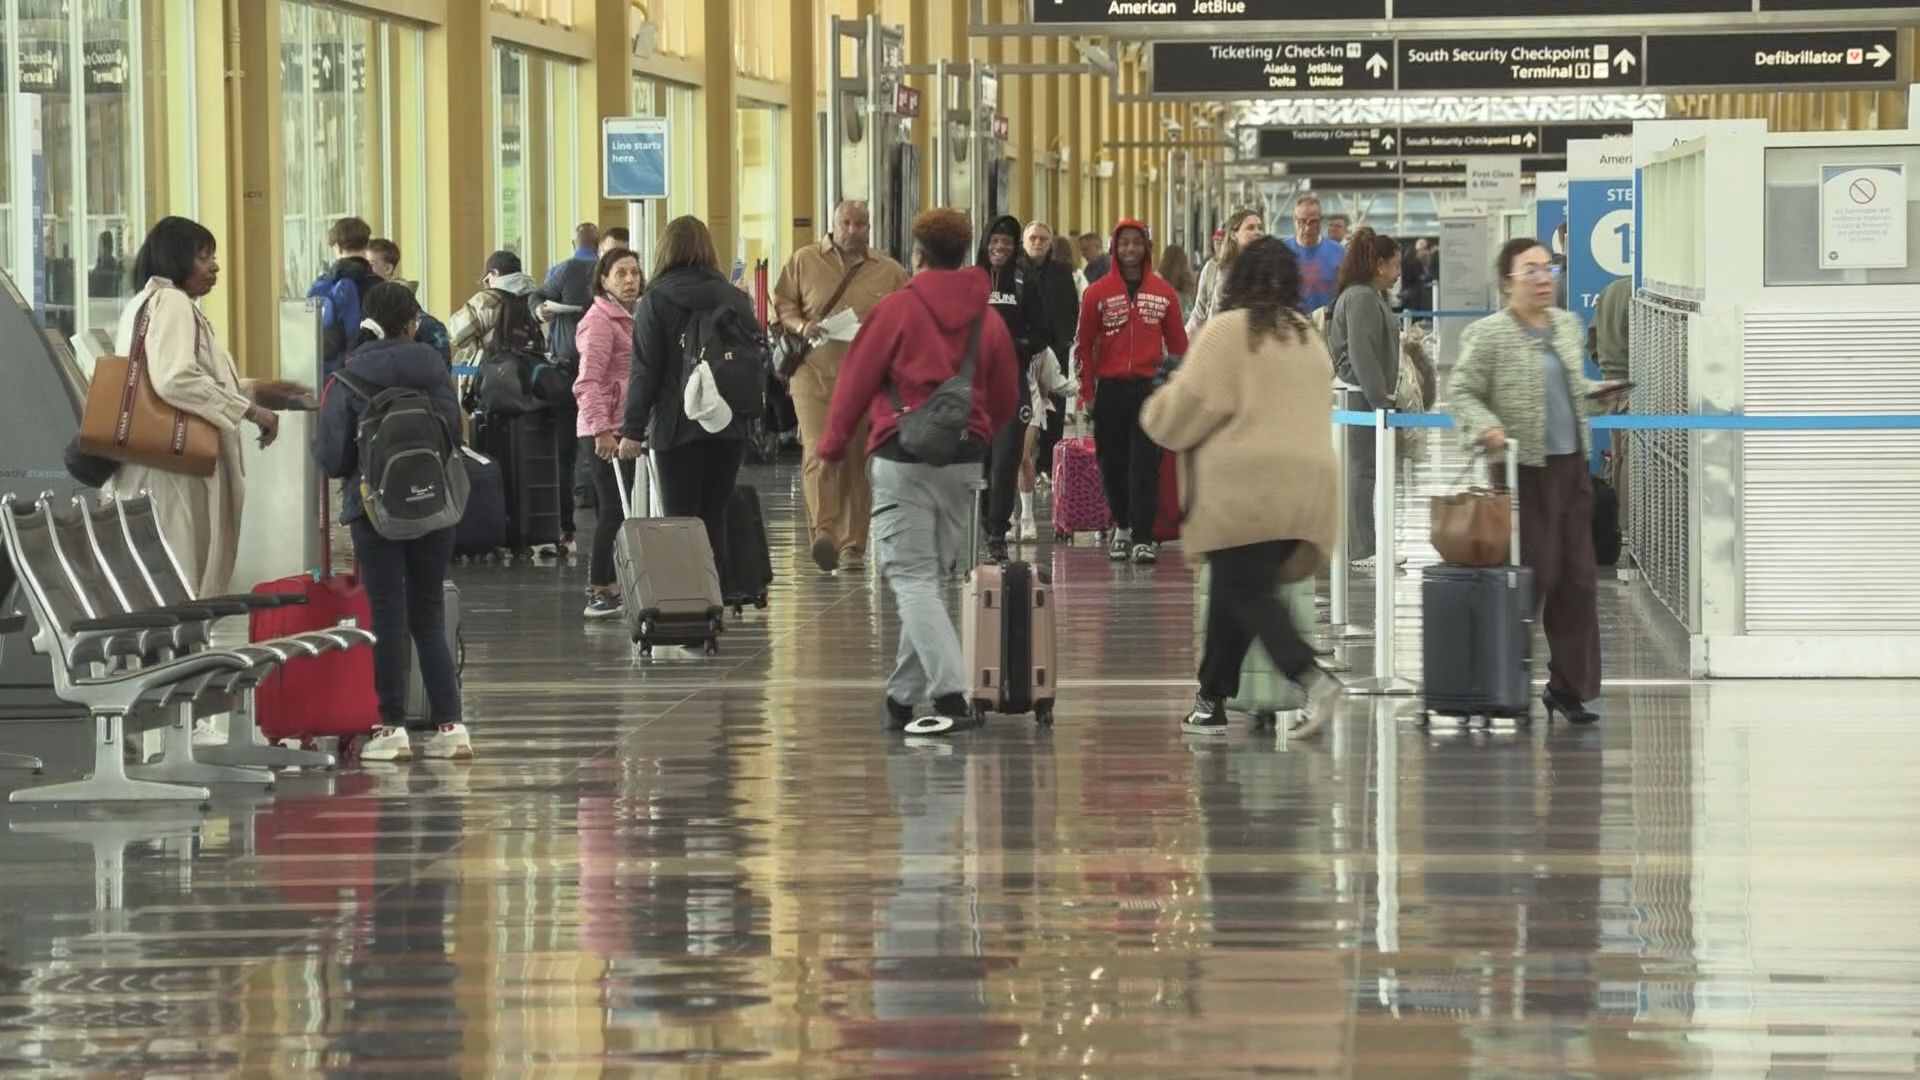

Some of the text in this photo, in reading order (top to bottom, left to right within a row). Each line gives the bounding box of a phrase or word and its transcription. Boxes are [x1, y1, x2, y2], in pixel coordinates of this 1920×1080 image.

[1107, 0, 1246, 15] American JetBlue
[1209, 44, 1344, 61] Ticketing / Check-In
[1408, 46, 1591, 65] South Security Checkpoint
[1755, 50, 1844, 66] Defibrillator
[1263, 62, 1344, 75] Alaska JetBlue
[1510, 64, 1573, 79] Terminal
[1269, 74, 1344, 88] Delta United
[612, 141, 662, 151] Line starts
[1406, 136, 1511, 148] South Security Checkpoint
[612, 153, 638, 164] here.
[1613, 222, 1632, 264] 1
